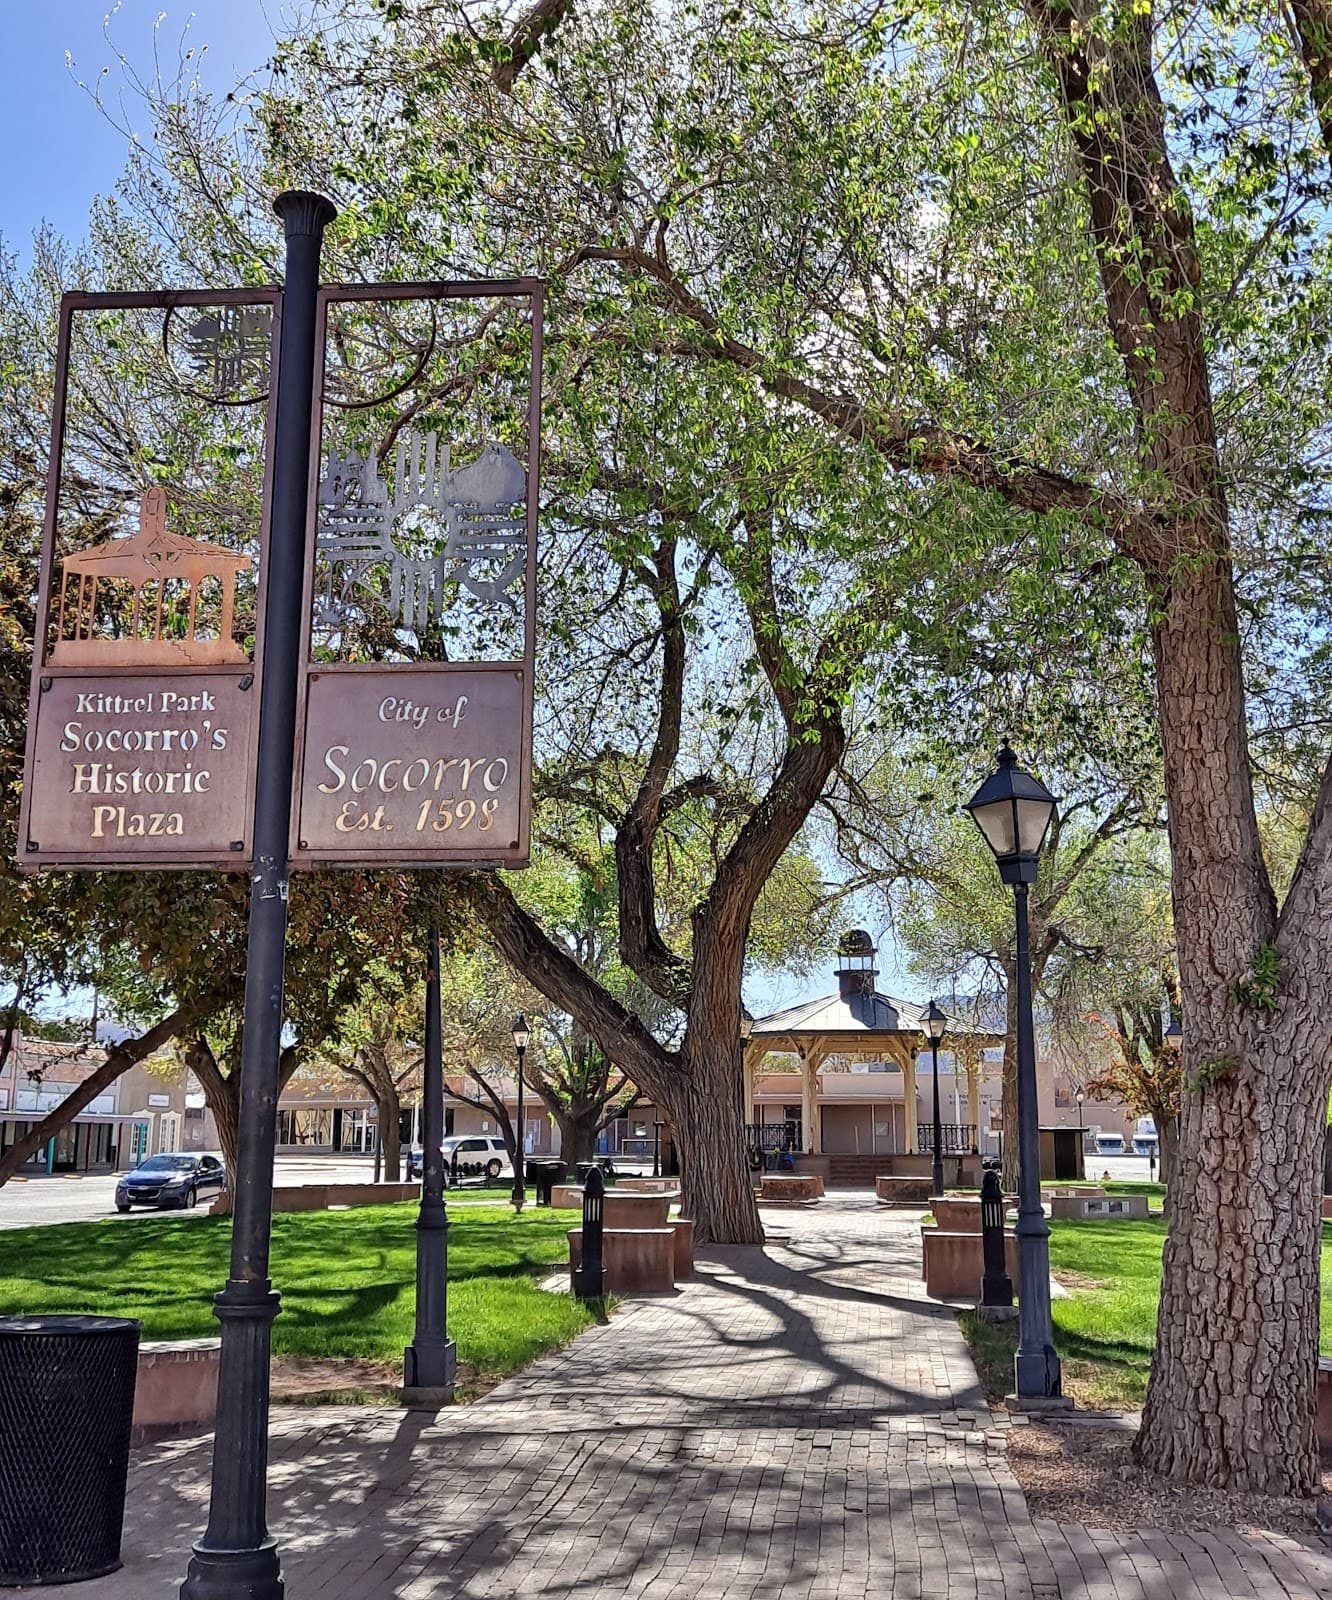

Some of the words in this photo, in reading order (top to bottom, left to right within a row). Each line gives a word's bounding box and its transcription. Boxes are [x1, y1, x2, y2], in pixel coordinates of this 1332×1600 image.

[76, 692, 152, 714] Kittrel
[160, 690, 216, 713] Park
[378, 696, 429, 730] City
[437, 695, 468, 729] of
[60, 720, 228, 752] Socorro's
[71, 762, 211, 794] Historic
[317, 745, 509, 794] Socorro
[91, 806, 184, 838] Plaza
[335, 800, 394, 832] Est.
[415, 798, 499, 832] 1598
